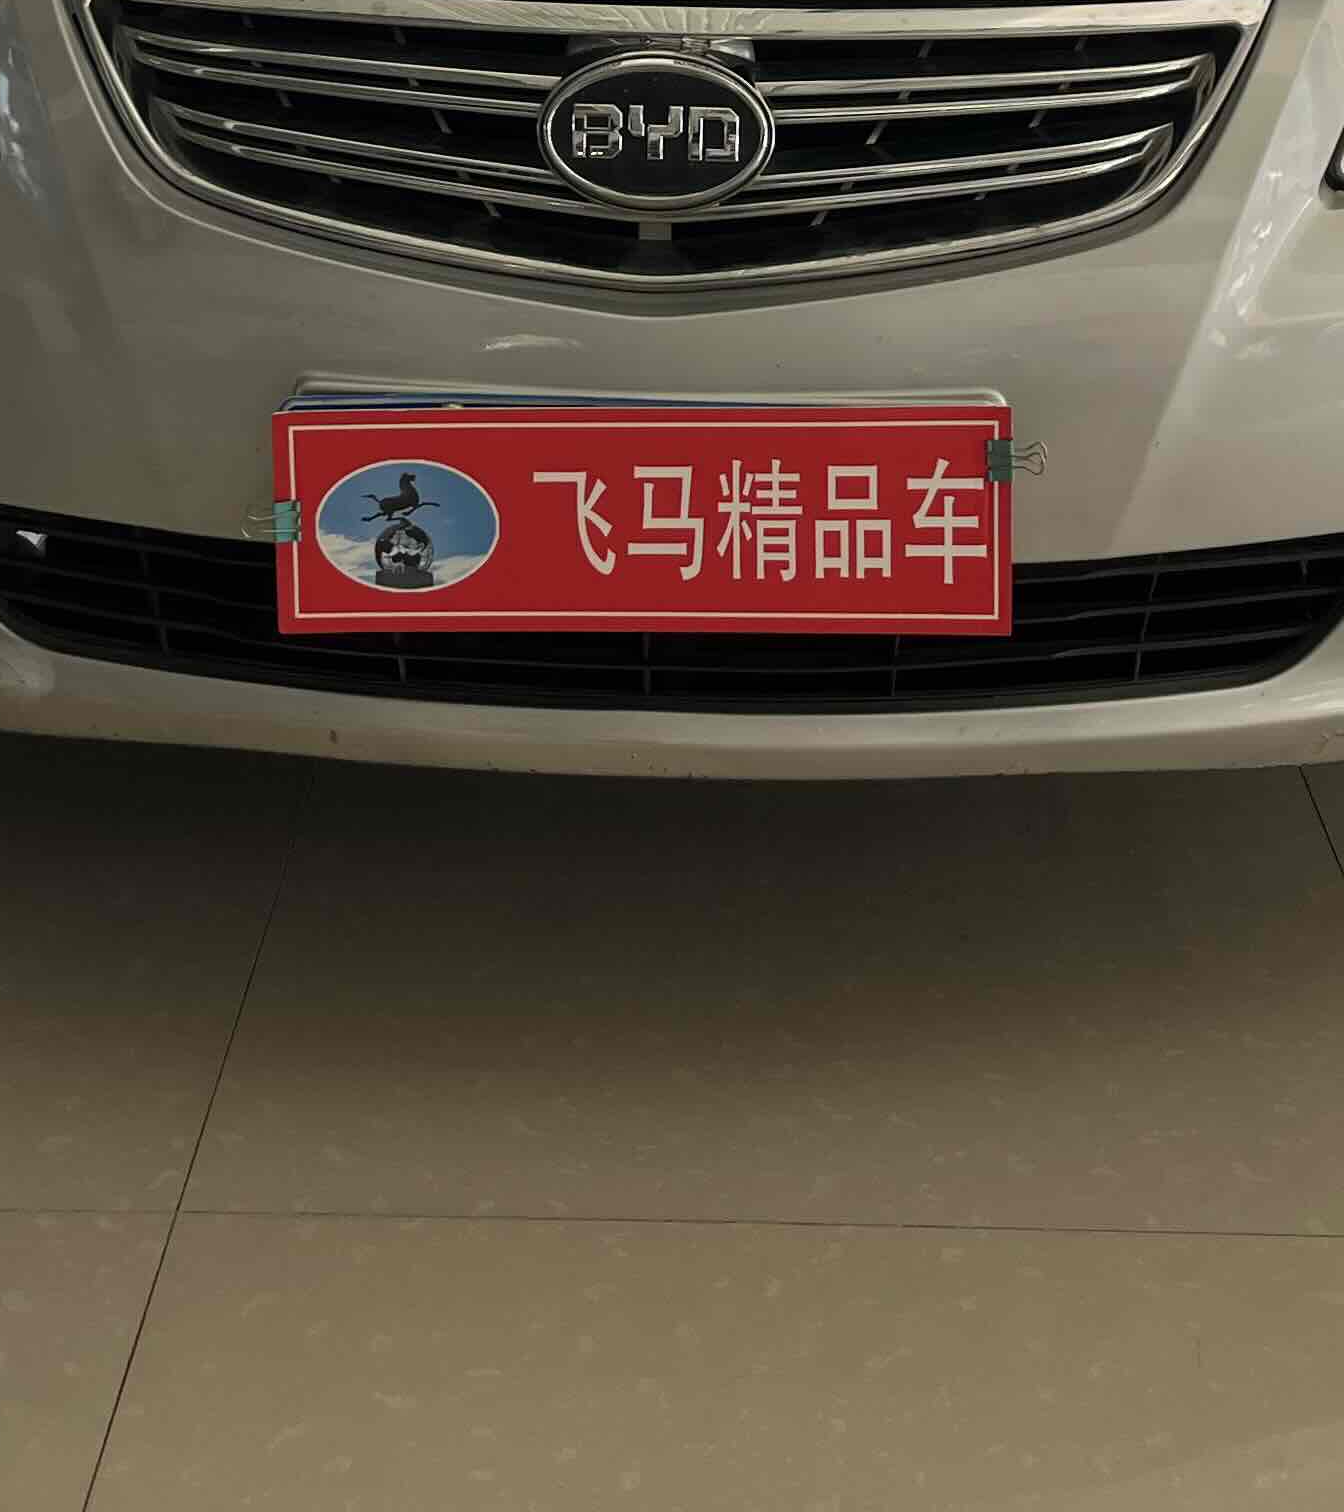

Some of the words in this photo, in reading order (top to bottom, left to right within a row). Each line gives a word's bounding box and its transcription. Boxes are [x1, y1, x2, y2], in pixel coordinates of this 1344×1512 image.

[571, 103, 740, 163] BYD
[532, 457, 989, 585] 飞马精品车
